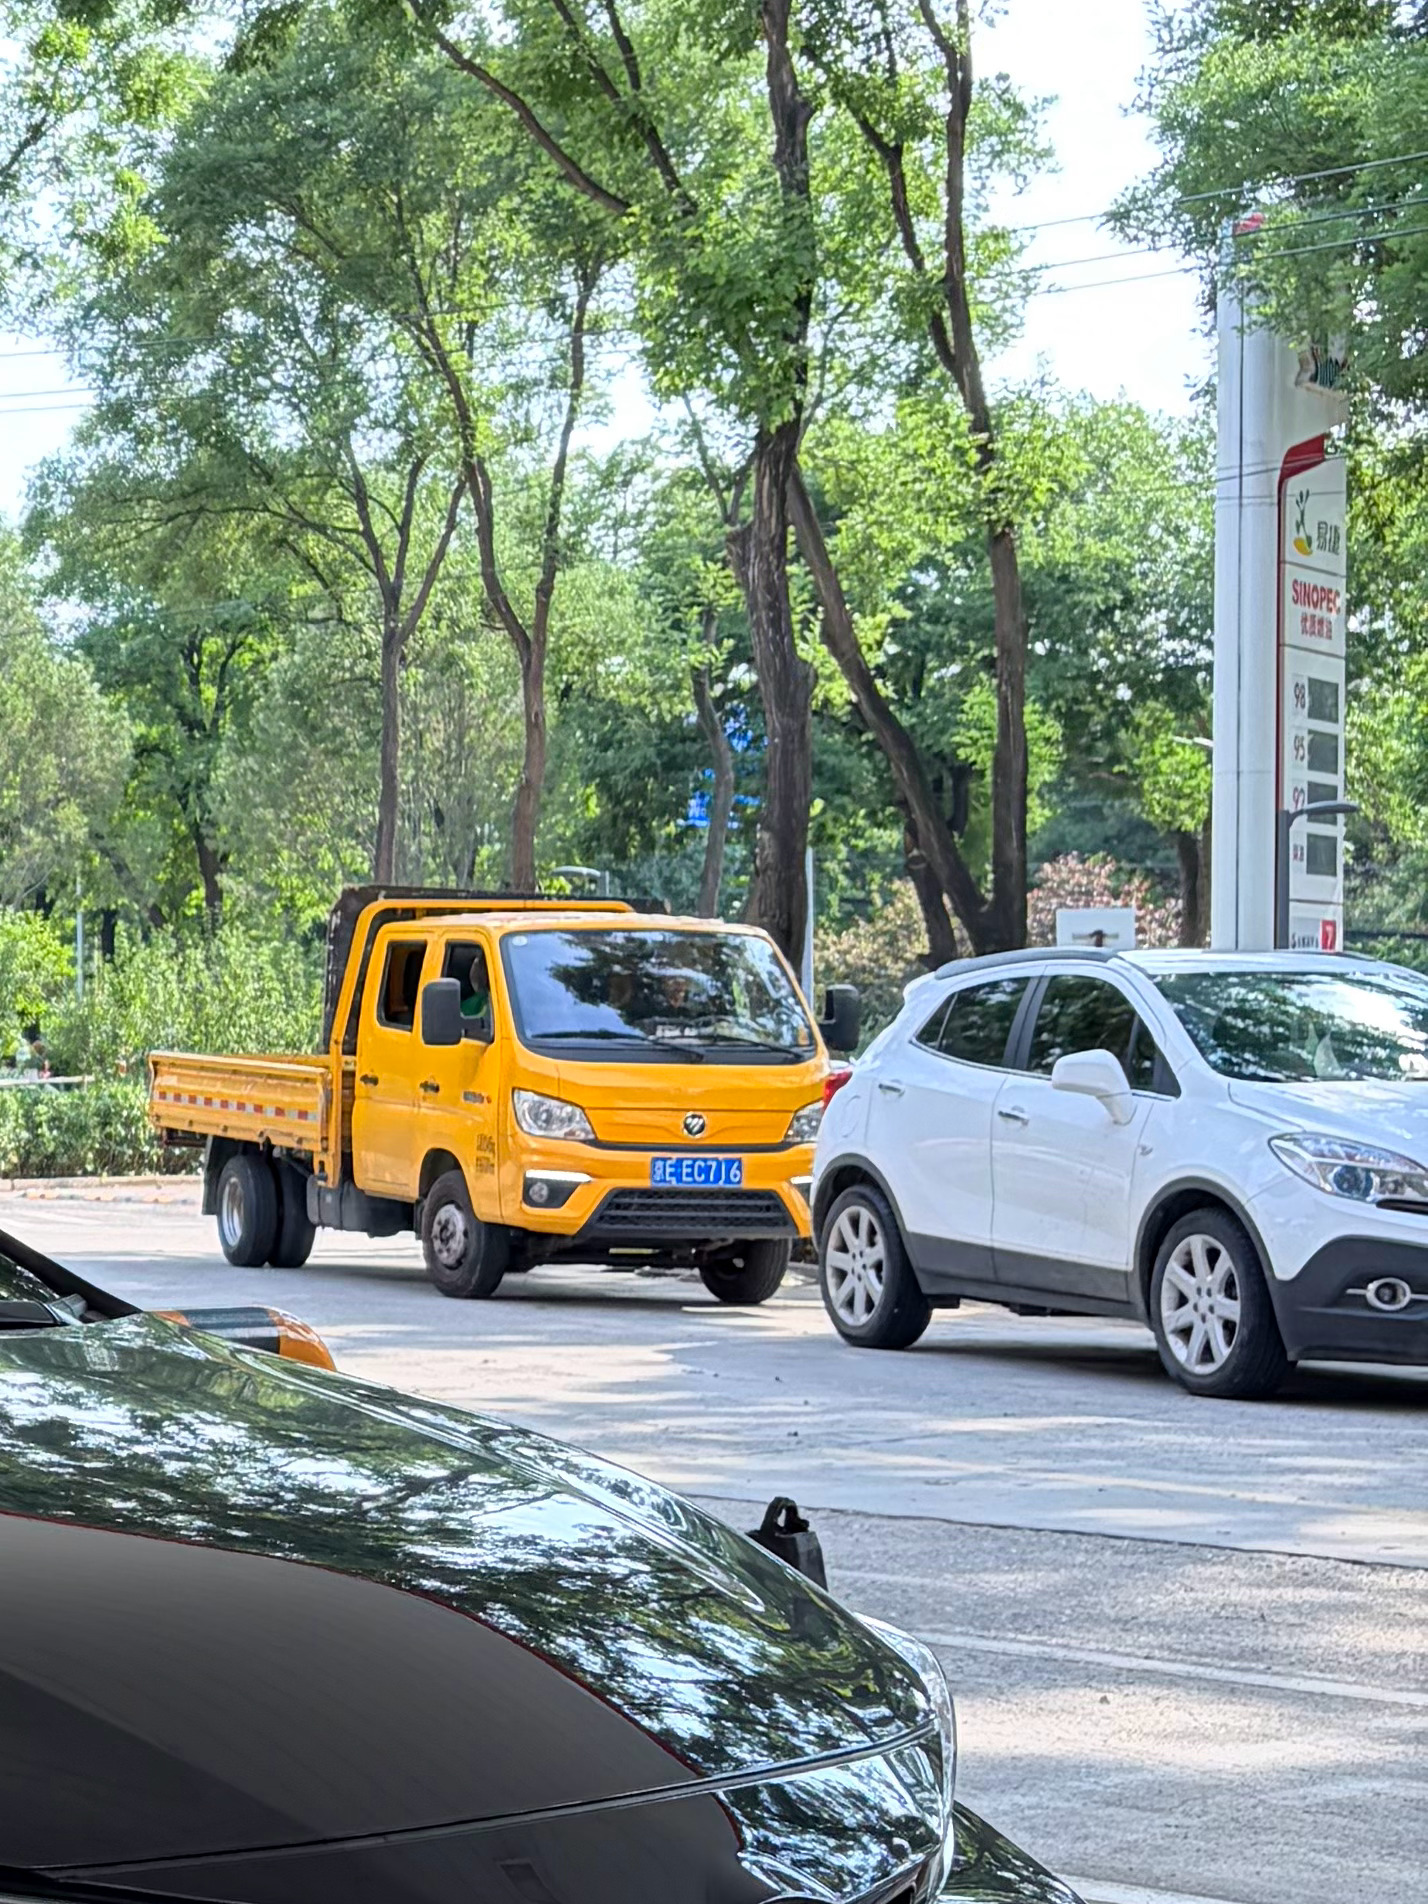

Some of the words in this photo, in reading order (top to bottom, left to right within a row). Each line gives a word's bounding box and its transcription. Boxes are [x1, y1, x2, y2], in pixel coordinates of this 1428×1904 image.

[1292, 578, 1341, 616] SINOPEC
[1293, 682, 1306, 709] 98
[1293, 734, 1306, 762] 95
